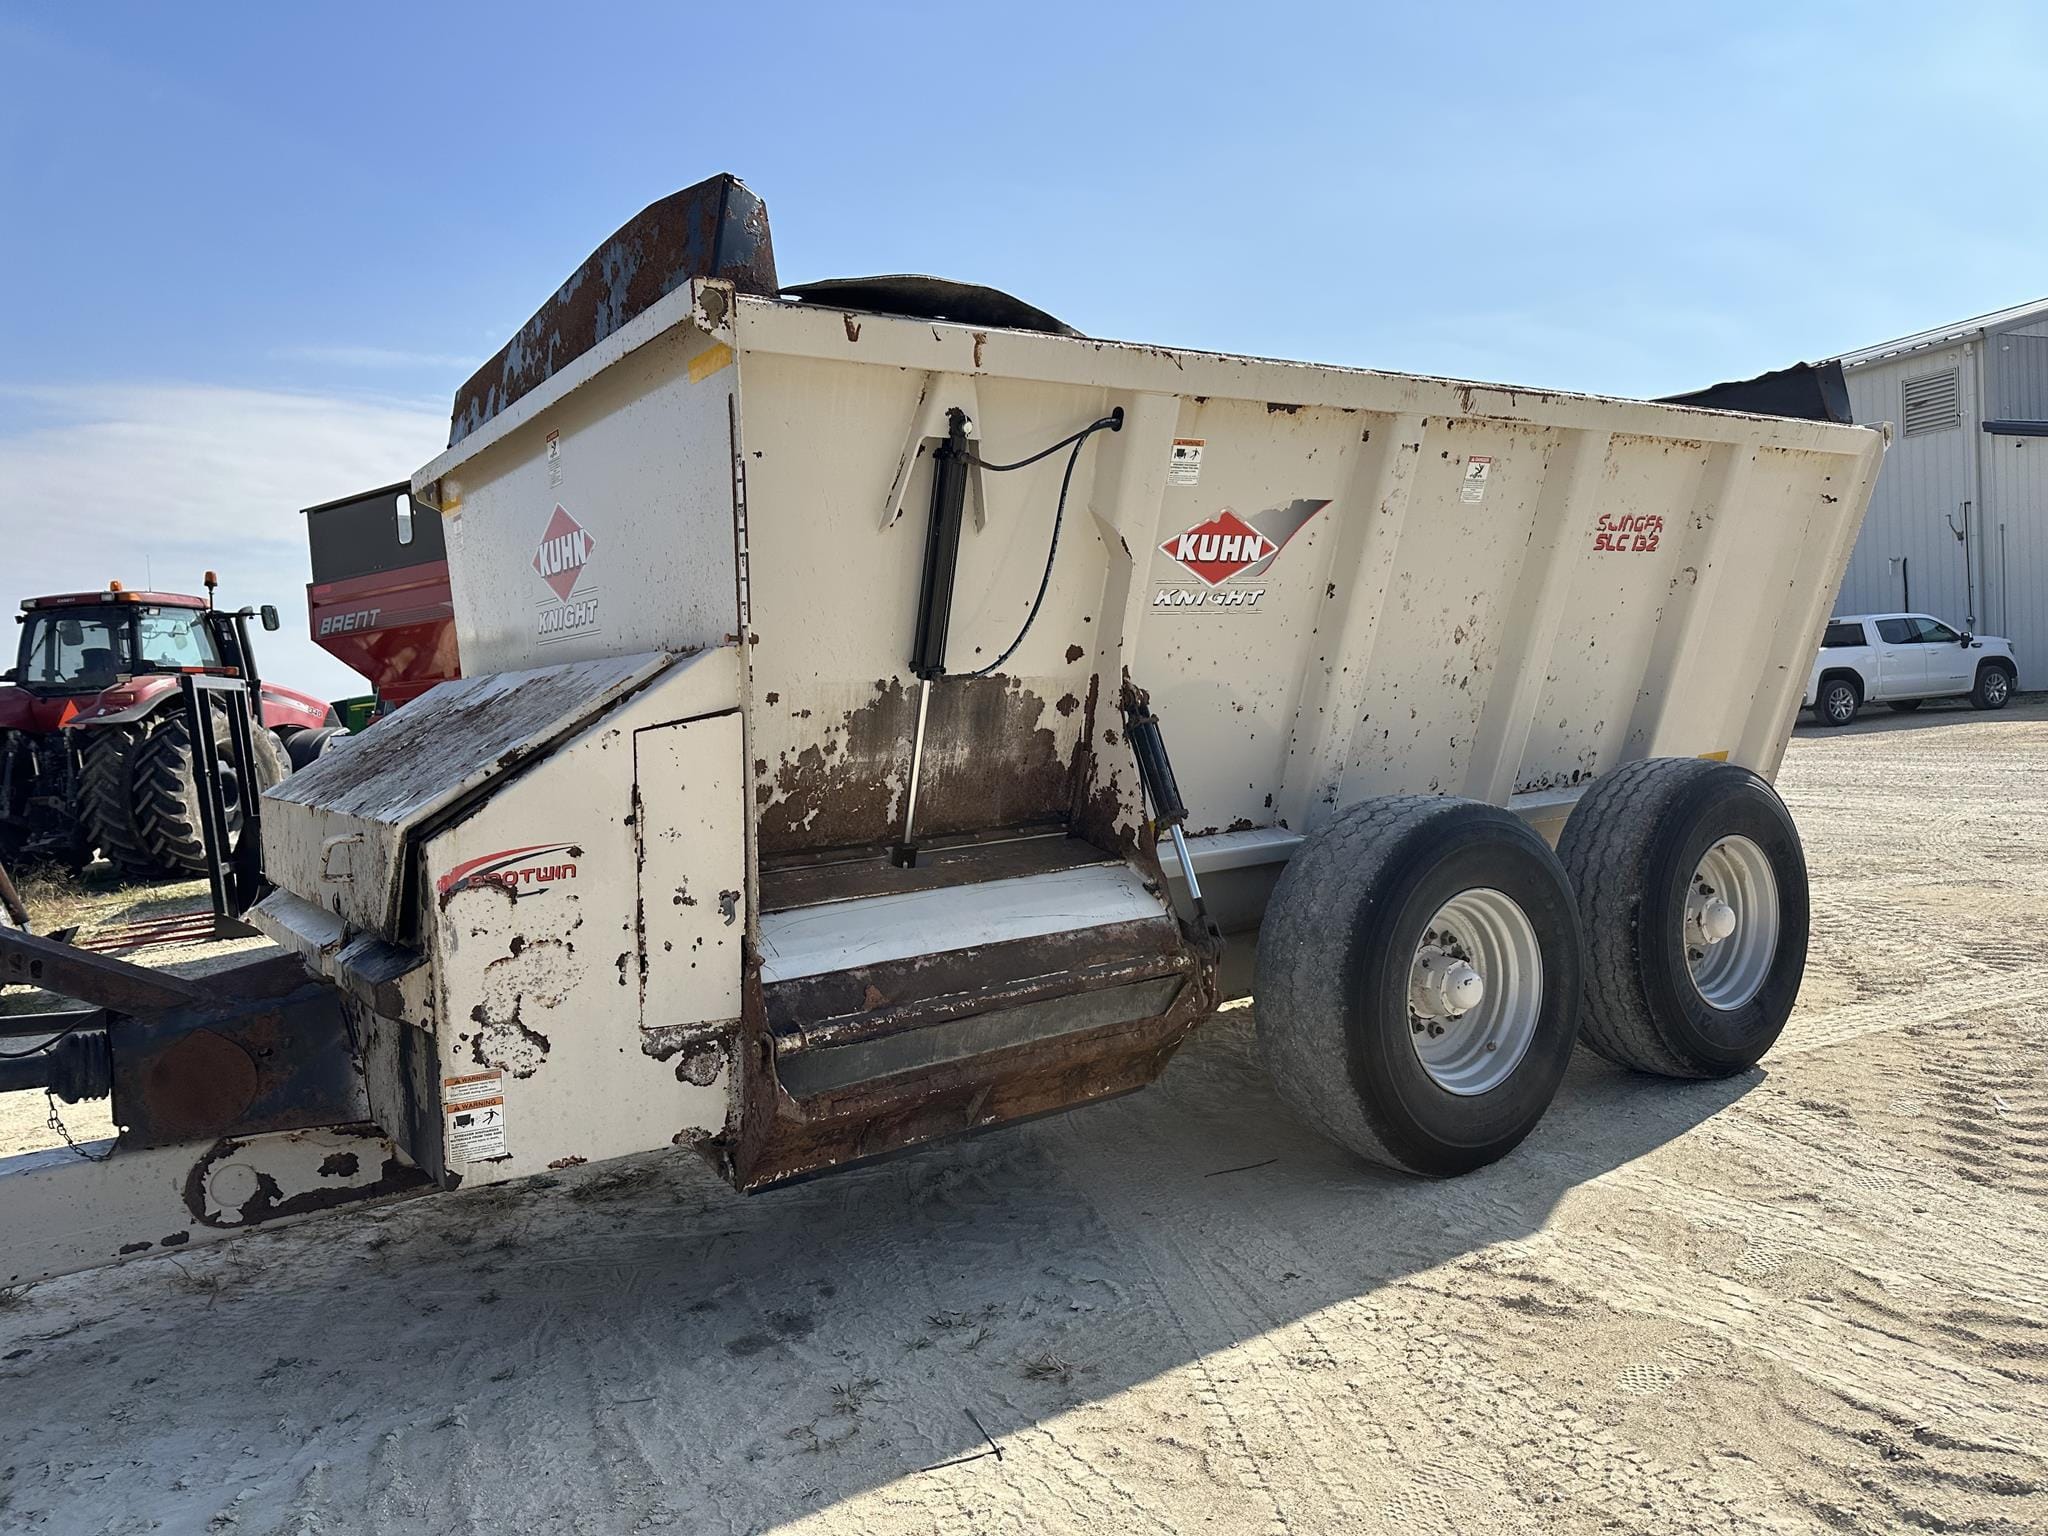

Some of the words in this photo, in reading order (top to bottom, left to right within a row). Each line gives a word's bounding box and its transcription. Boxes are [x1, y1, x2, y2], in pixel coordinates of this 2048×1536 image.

[540, 528, 586, 578] KUHN
[1175, 533, 1264, 563] KUHN
[1593, 533, 1630, 551] SLC
[1631, 534, 1660, 552] 132
[1153, 589, 1265, 607] KNIGHT
[320, 608, 381, 635] BRENT
[538, 599, 598, 634] KNIGHT
[462, 1099, 496, 1109] WARNING
